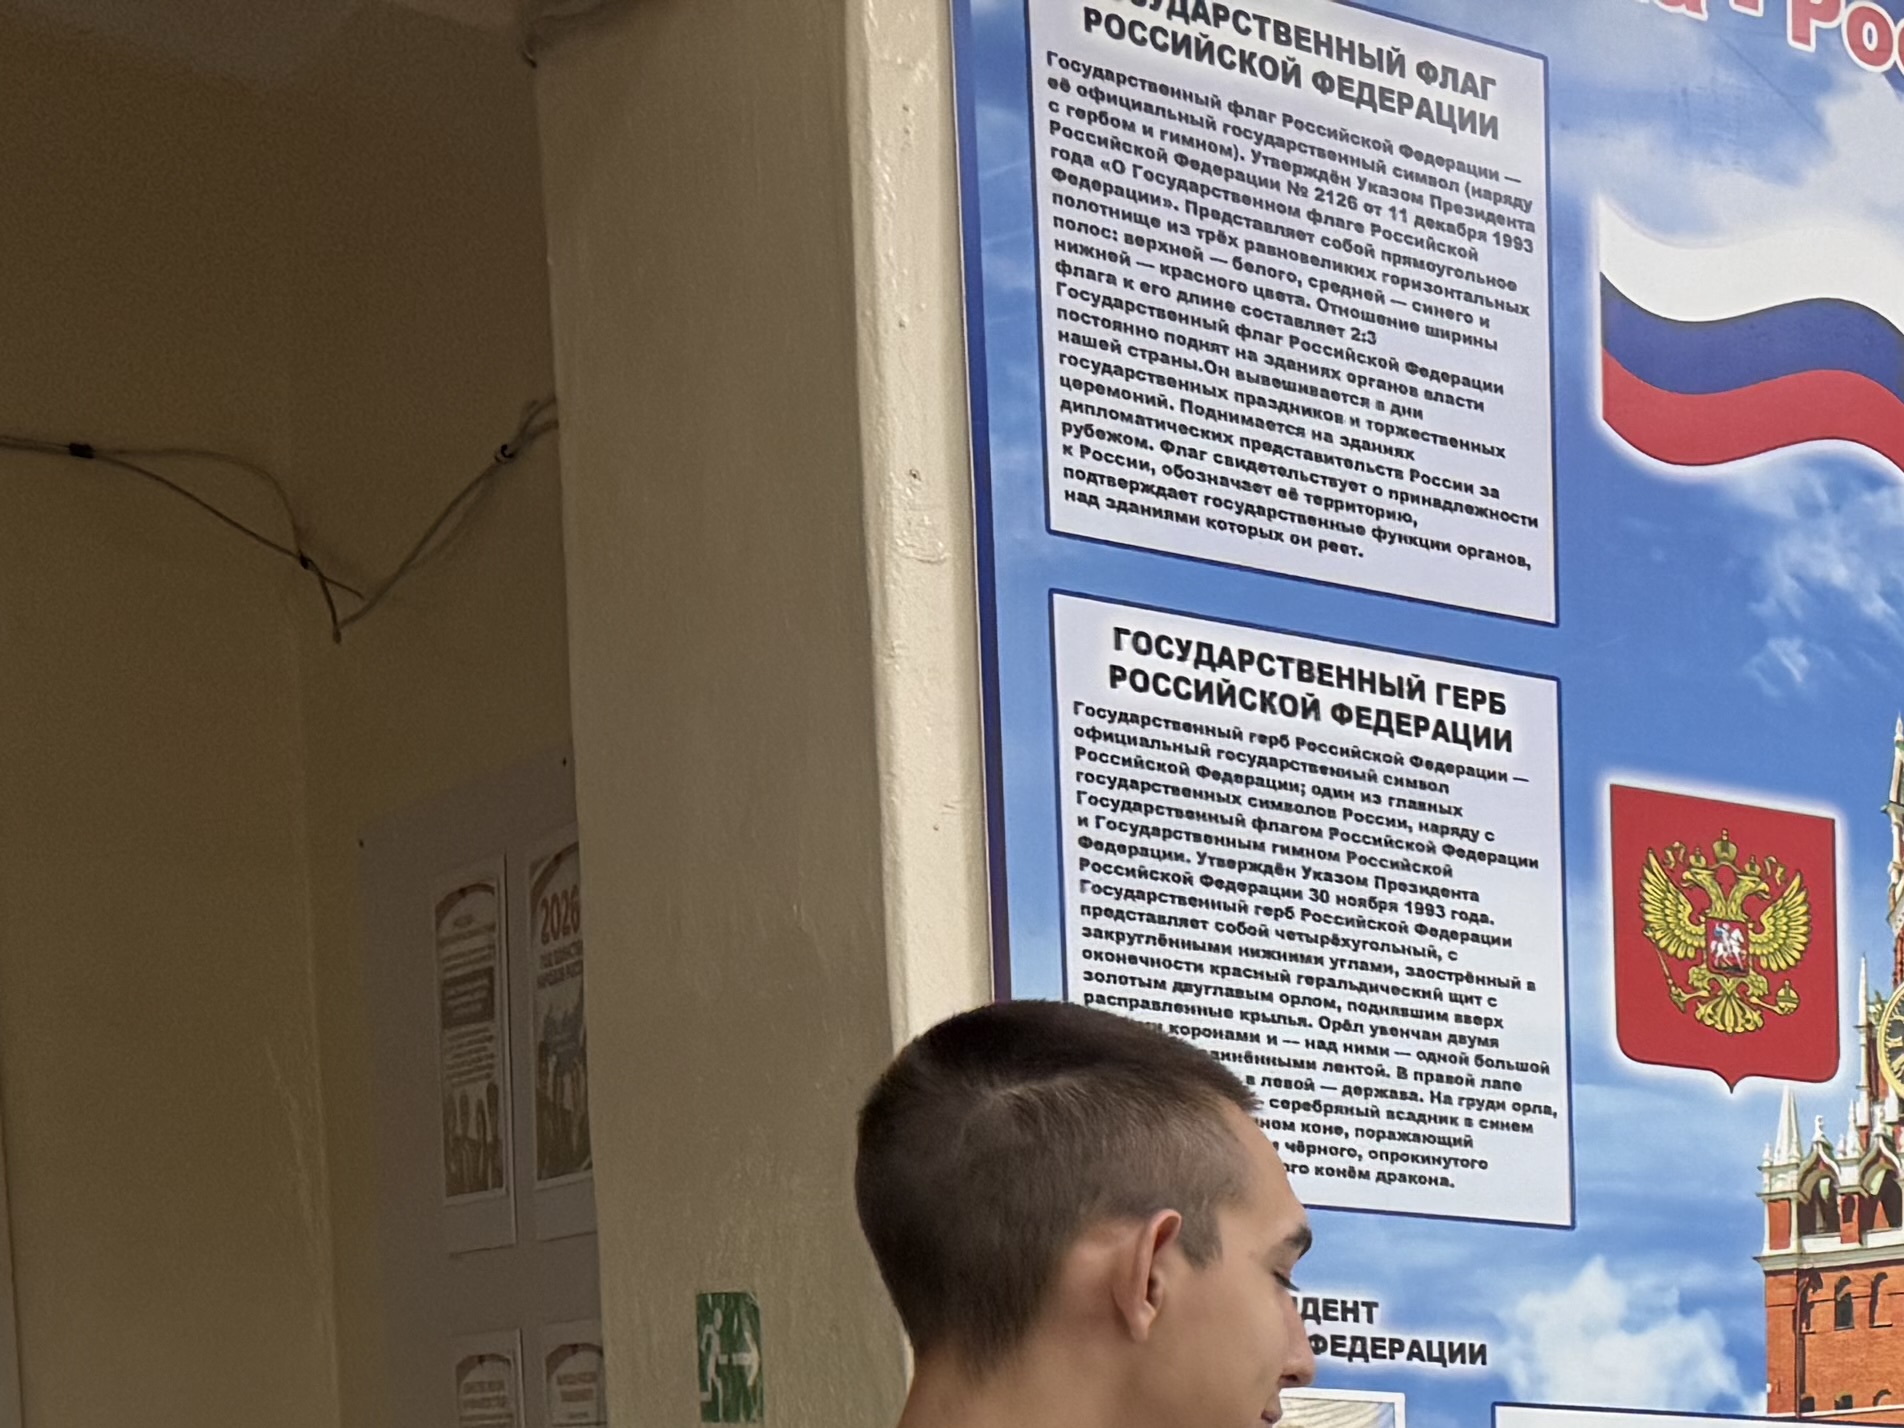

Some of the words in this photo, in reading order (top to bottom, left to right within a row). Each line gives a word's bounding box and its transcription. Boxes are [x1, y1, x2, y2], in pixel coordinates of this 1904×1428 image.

[1082, 5, 1302, 89] РОССИЙСКОЙ
[1311, 69, 1498, 140] ФЕДЕРАЦИИ
[1415, 59, 1497, 101] ФЛАГ
[1046, 76, 1071, 93] её
[1075, 84, 1217, 132] официальный
[1222, 122, 1387, 175] государственный
[1391, 165, 1460, 193] символ
[1463, 180, 1533, 214] (наряду
[1047, 100, 1060, 114] с
[1065, 104, 1136, 133] гербом
[1141, 123, 1154, 138] и
[1159, 128, 1245, 162] гимном).
[1250, 148, 1351, 188] Утверждён
[1356, 175, 1424, 206] Указом
[1428, 193, 1536, 233] Президента
[1048, 119, 1168, 164] Российской
[1173, 151, 1281, 192] Федерации
[1286, 179, 1309, 198] №
[1313, 185, 1358, 211] 2126
[1362, 201, 1383, 217] от
[1387, 205, 1408, 224] 11
[1413, 214, 1487, 243] декабря
[1491, 230, 1534, 254] 1993
[1062, 465, 1199, 504] подтверждает
[1202, 494, 1366, 536] государственные
[1370, 524, 1452, 553] функции
[1456, 543, 1532, 571] органов,
[1108, 663, 1322, 722] РОССИЙСКОЙ
[1329, 701, 1513, 753] ФЕДЕРАЦИИ
[1112, 625, 1426, 703] ГОСУДАРСТВЕННЫЙ
[1435, 681, 1507, 716] ГЕРБ
[1075, 770, 1243, 807] государственных
[1247, 796, 1337, 820] символов
[1341, 806, 1413, 834] России,
[1417, 820, 1480, 844] наряду
[1483, 830, 1495, 842] с
[1075, 789, 1246, 828] Государственный
[1250, 815, 1324, 839] флагом
[1327, 826, 1437, 855] Российской
[1440, 842, 1539, 869] Федерации
[1076, 834, 1191, 864] Федерации.
[1195, 850, 1297, 879] Утверждён
[1300, 864, 1369, 888] Указом
[1373, 874, 1480, 903] Президента
[1078, 856, 1194, 887] Российской
[1198, 873, 1304, 901] Федерации
[1307, 886, 1331, 904] 30
[1334, 893, 1399, 915] ноября
[1403, 899, 1446, 919] 1993
[1450, 908, 1495, 926] года.
[1308, 1333, 1487, 1368] ФЕДЕРАЦИИ
